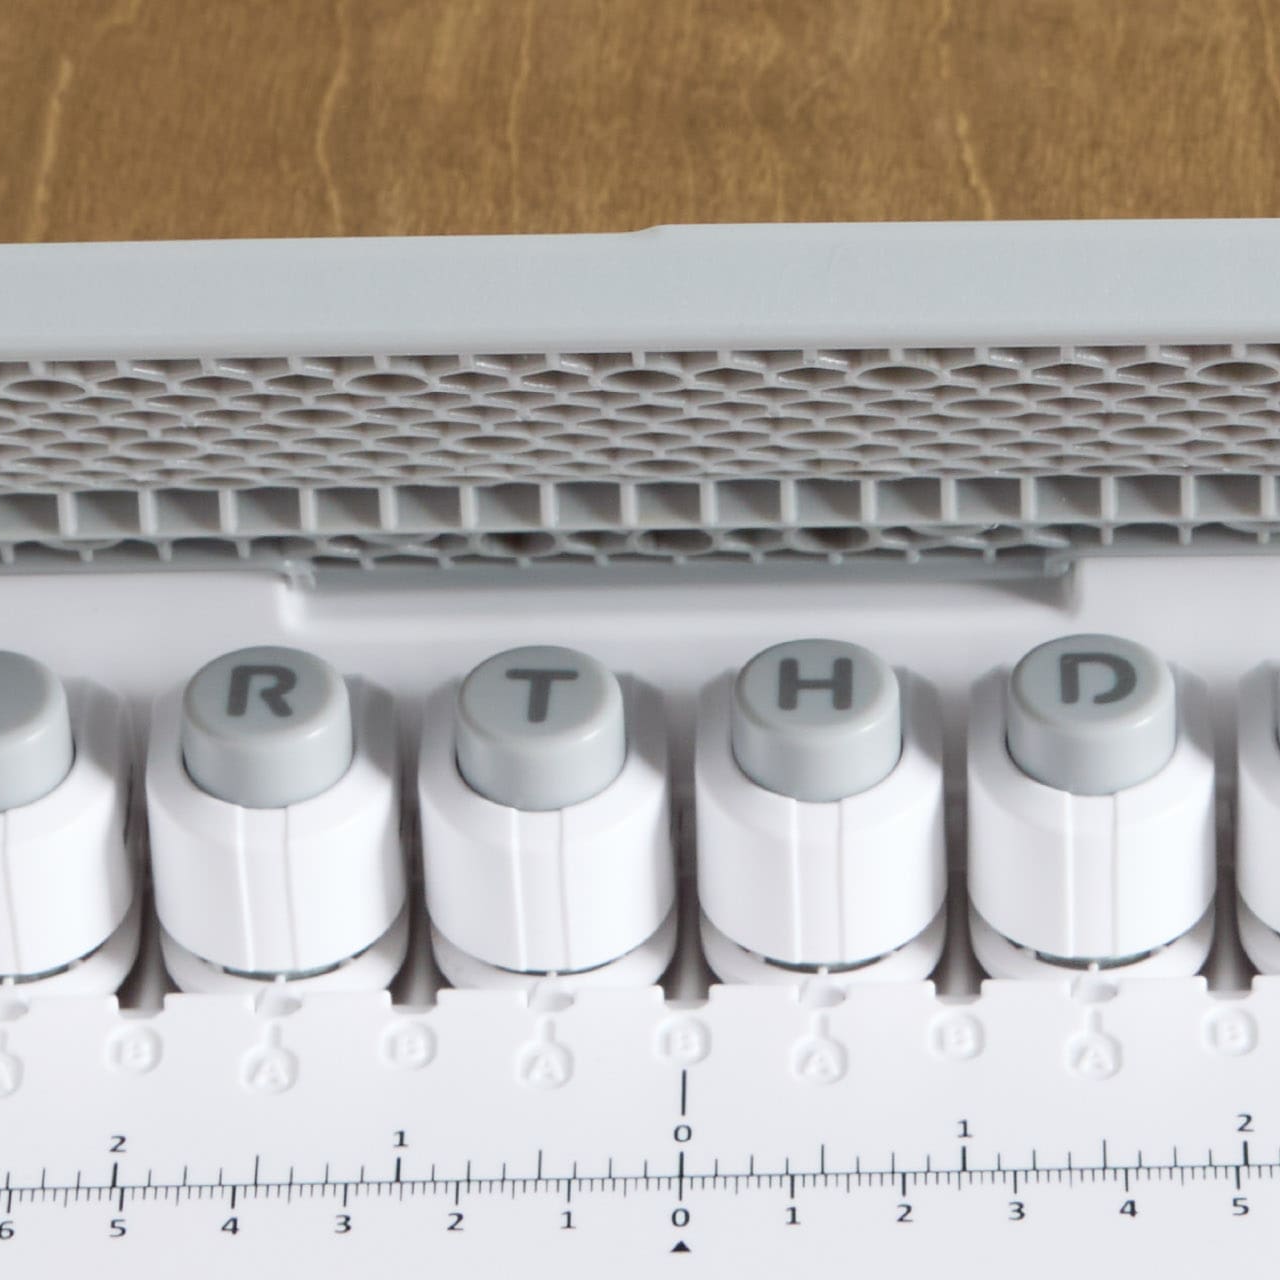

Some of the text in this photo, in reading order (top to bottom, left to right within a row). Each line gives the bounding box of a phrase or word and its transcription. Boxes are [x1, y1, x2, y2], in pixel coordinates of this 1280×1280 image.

[225, 664, 294, 718] R
[505, 669, 579, 724] T
[778, 658, 854, 711] H
[1058, 653, 1136, 704] D
[109, 1135, 127, 1153] 2
[394, 1130, 407, 1148] 1
[673, 1124, 693, 1143] 0
[958, 1119, 971, 1138] 1
[1237, 1113, 1253, 1133] 2
[110, 1219, 127, 1238] 5
[220, 1217, 240, 1236] 4
[335, 1214, 352, 1234] 3
[447, 1212, 464, 1231] 2
[562, 1210, 574, 1230] 1
[671, 1208, 691, 1228] 0
[787, 1206, 799, 1225] 1
[896, 1203, 913, 1223] 2
[1009, 1201, 1026, 1221] 3
[1119, 1199, 1138, 1218] 4
[1232, 1197, 1250, 1216] 5
